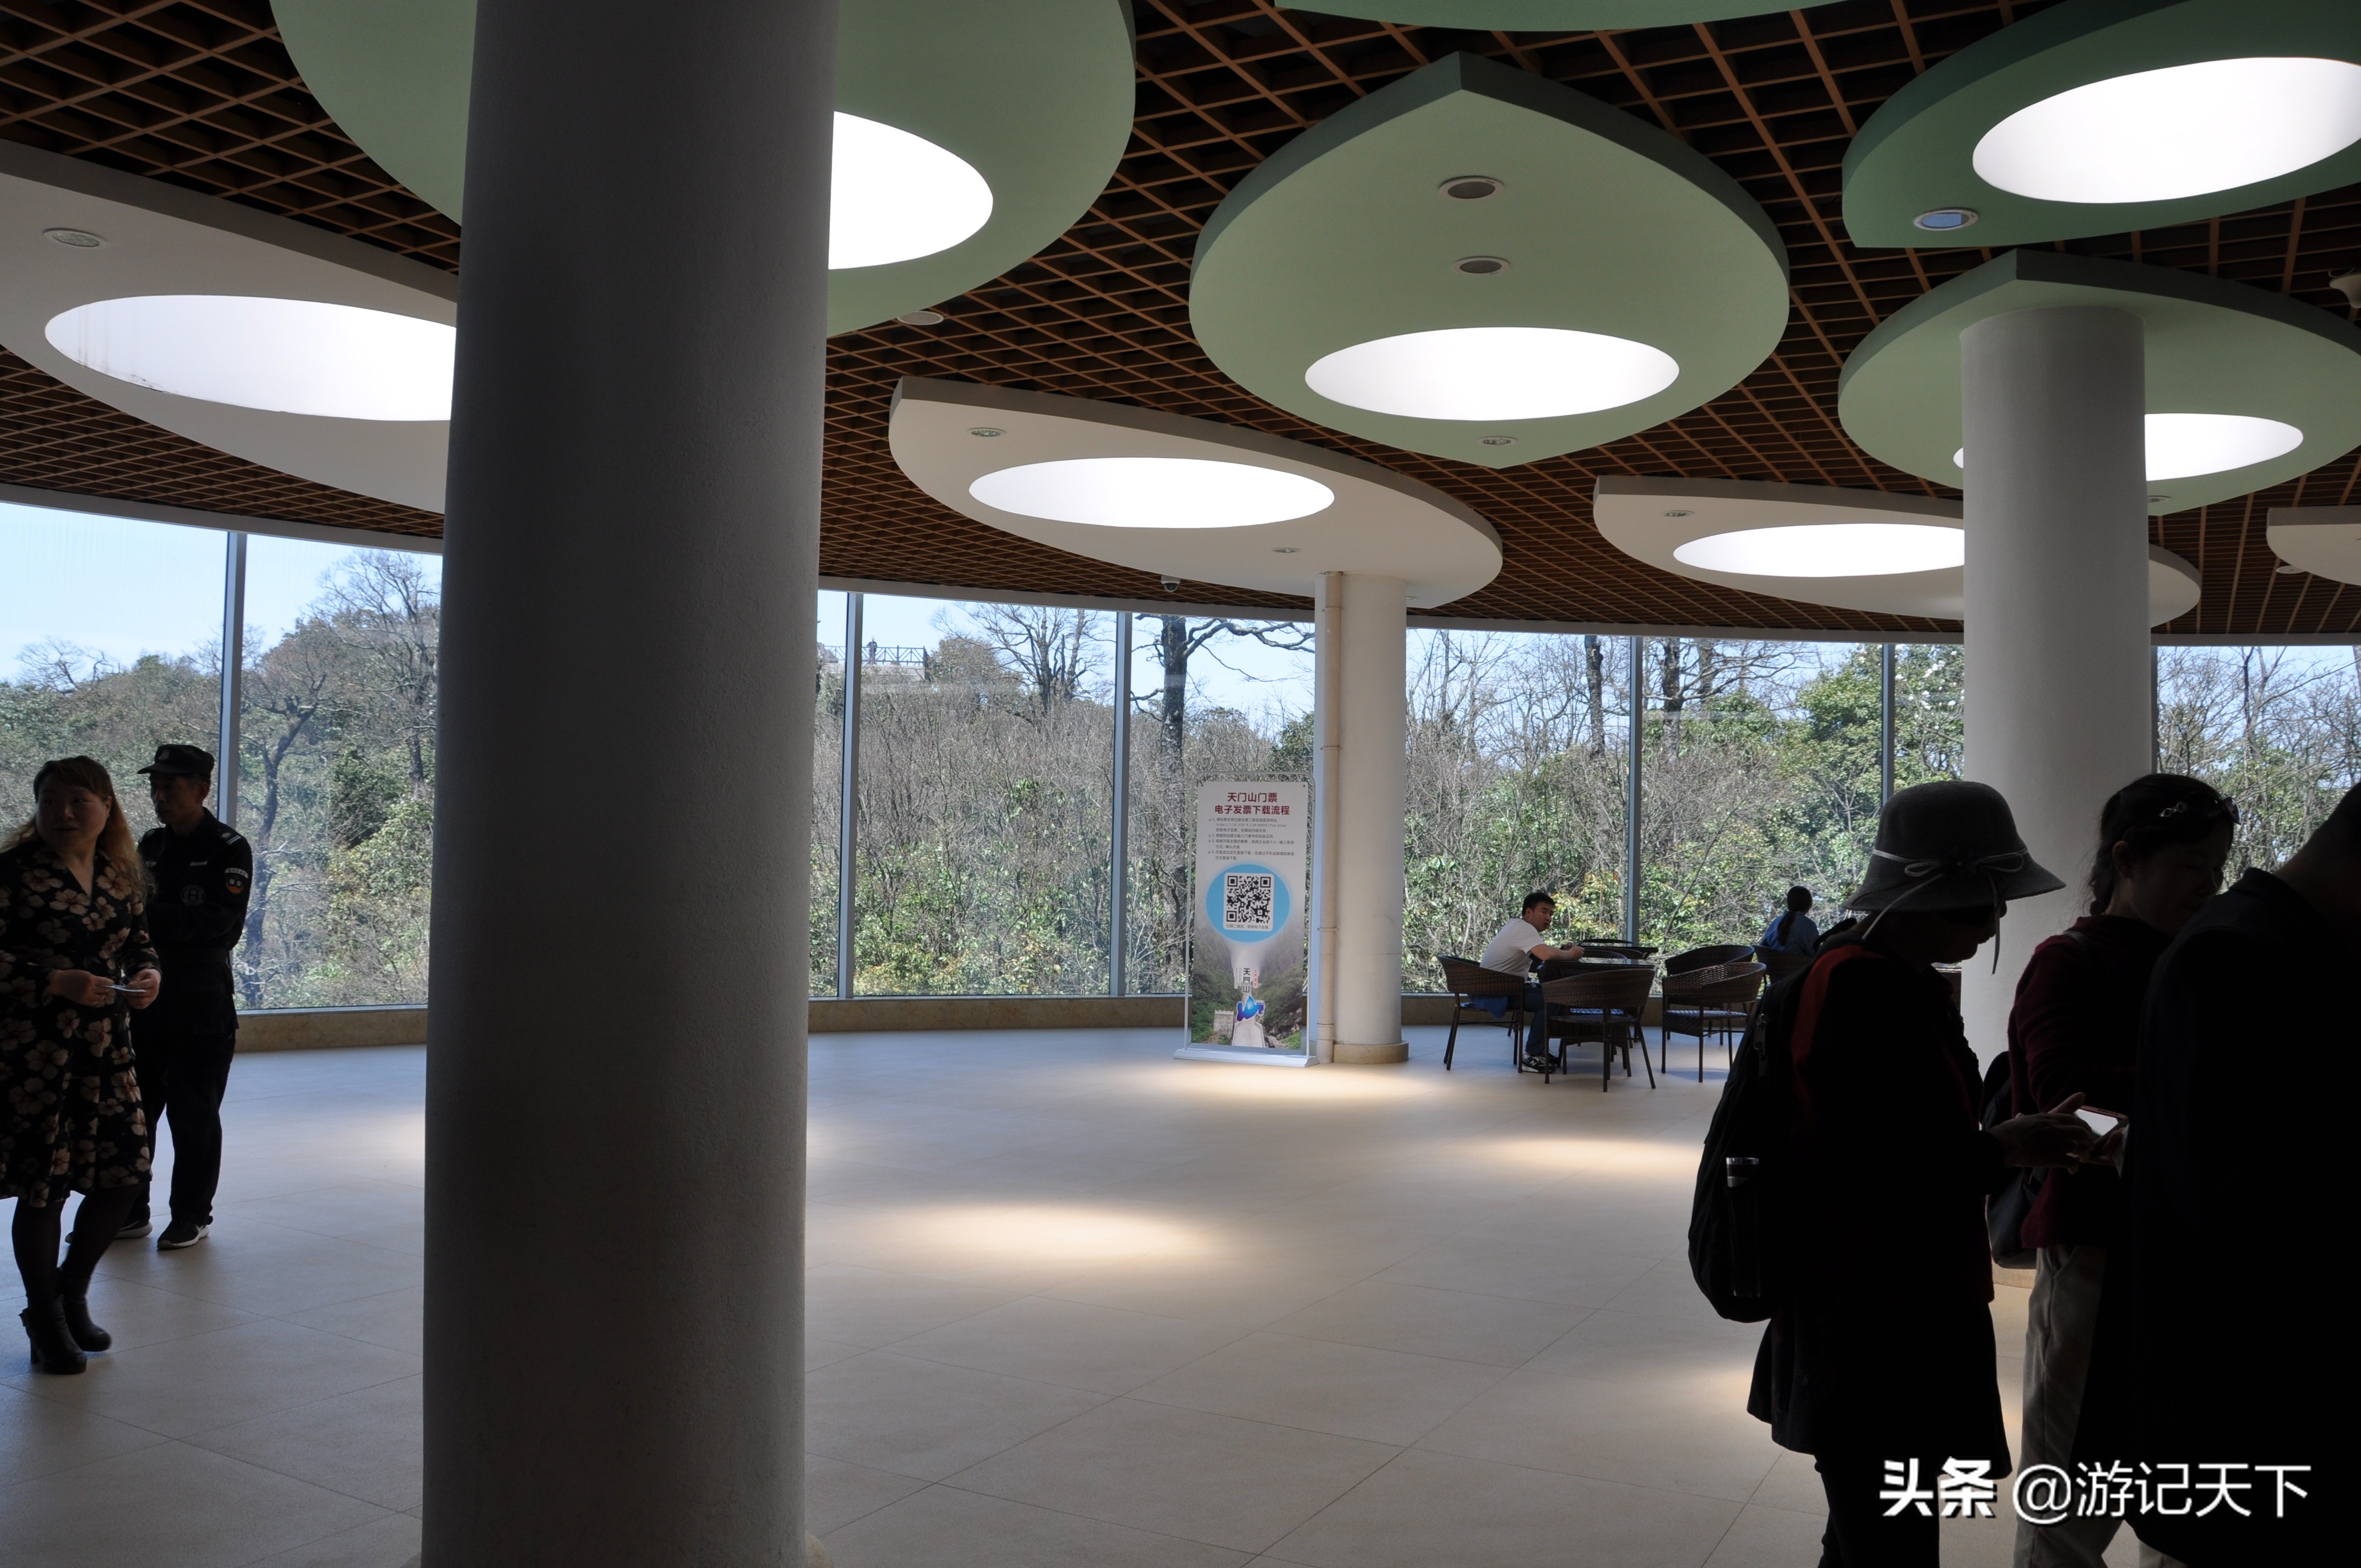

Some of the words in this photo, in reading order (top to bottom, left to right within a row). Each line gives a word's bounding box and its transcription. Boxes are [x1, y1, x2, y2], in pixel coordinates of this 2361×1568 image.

[1227, 792, 1277, 802] 天门山门票
[1215, 804, 1290, 815] 电子发票下载流程
[1243, 967, 1251, 993] 天門山
